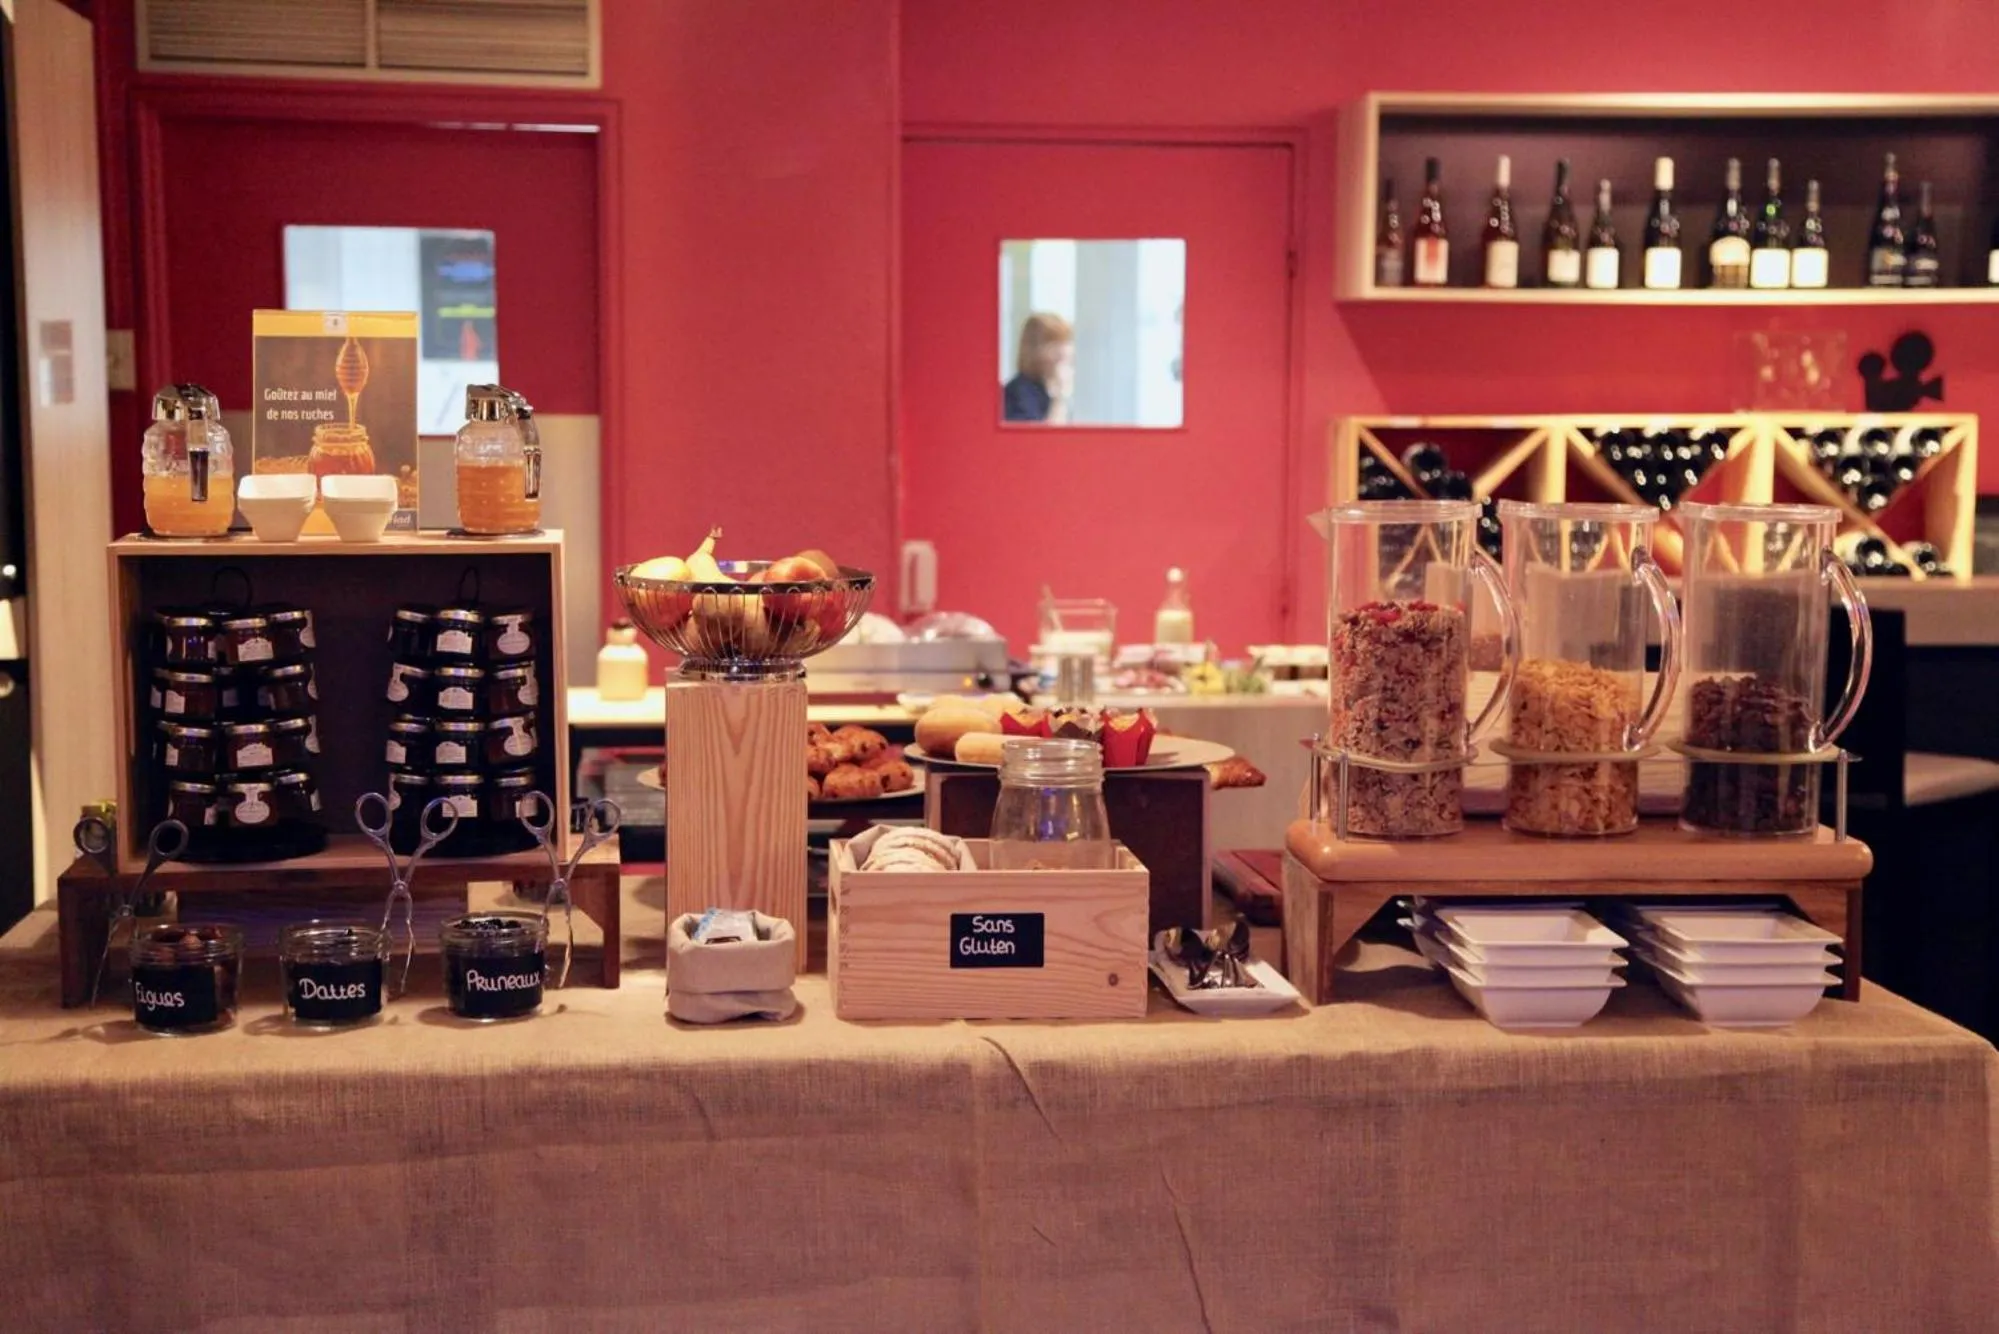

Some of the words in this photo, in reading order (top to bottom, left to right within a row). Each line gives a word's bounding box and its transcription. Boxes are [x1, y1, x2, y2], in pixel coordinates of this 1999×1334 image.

[264, 388, 299, 401] Goûtez
[301, 391, 313, 401] au
[315, 388, 337, 401] miel
[266, 408, 279, 420] de
[281, 410, 299, 420] nos
[301, 408, 334, 420] ruches
[972, 915, 1015, 933] Sans
[959, 936, 1015, 955] Gluten
[135, 981, 185, 1012] Figues
[299, 977, 366, 1000] Dattes
